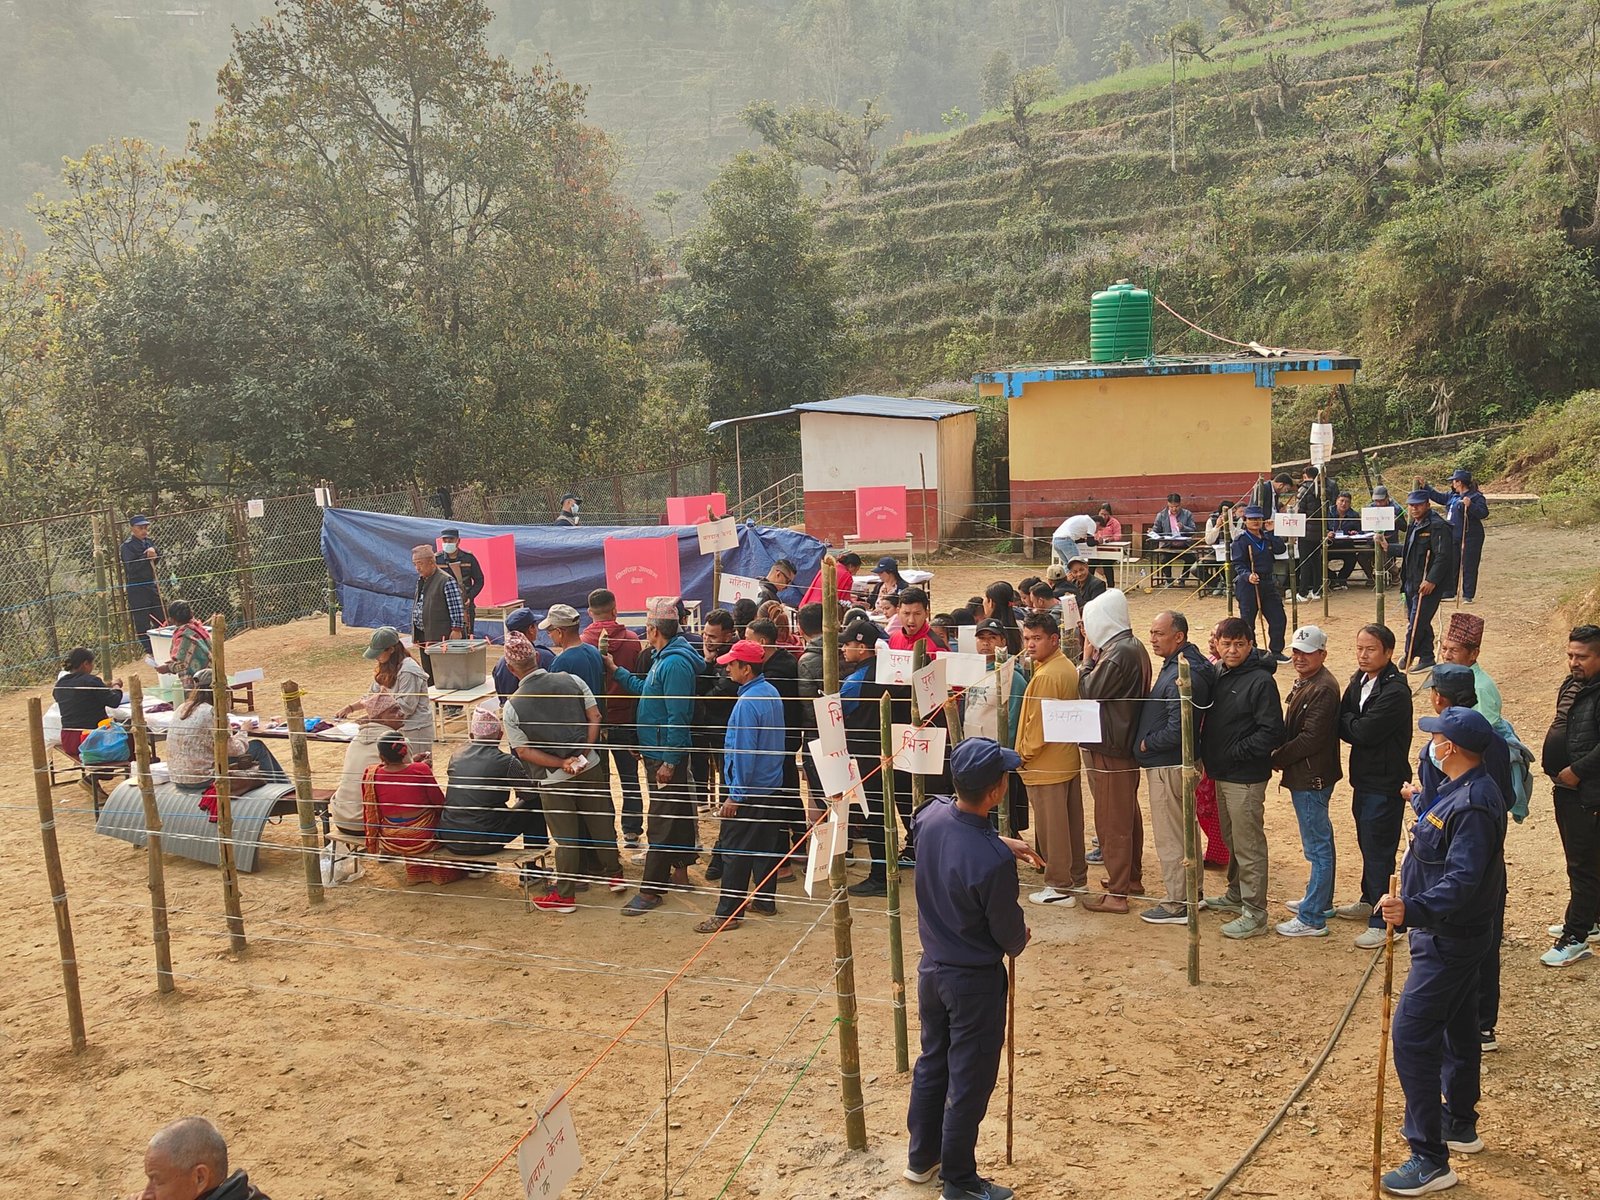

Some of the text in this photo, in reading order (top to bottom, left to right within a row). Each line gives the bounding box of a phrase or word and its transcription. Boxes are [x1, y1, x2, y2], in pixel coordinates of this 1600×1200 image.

[729, 577, 751, 589] महिला
[890, 654, 911, 668] पुरुष
[902, 730, 931, 754] भित्र
